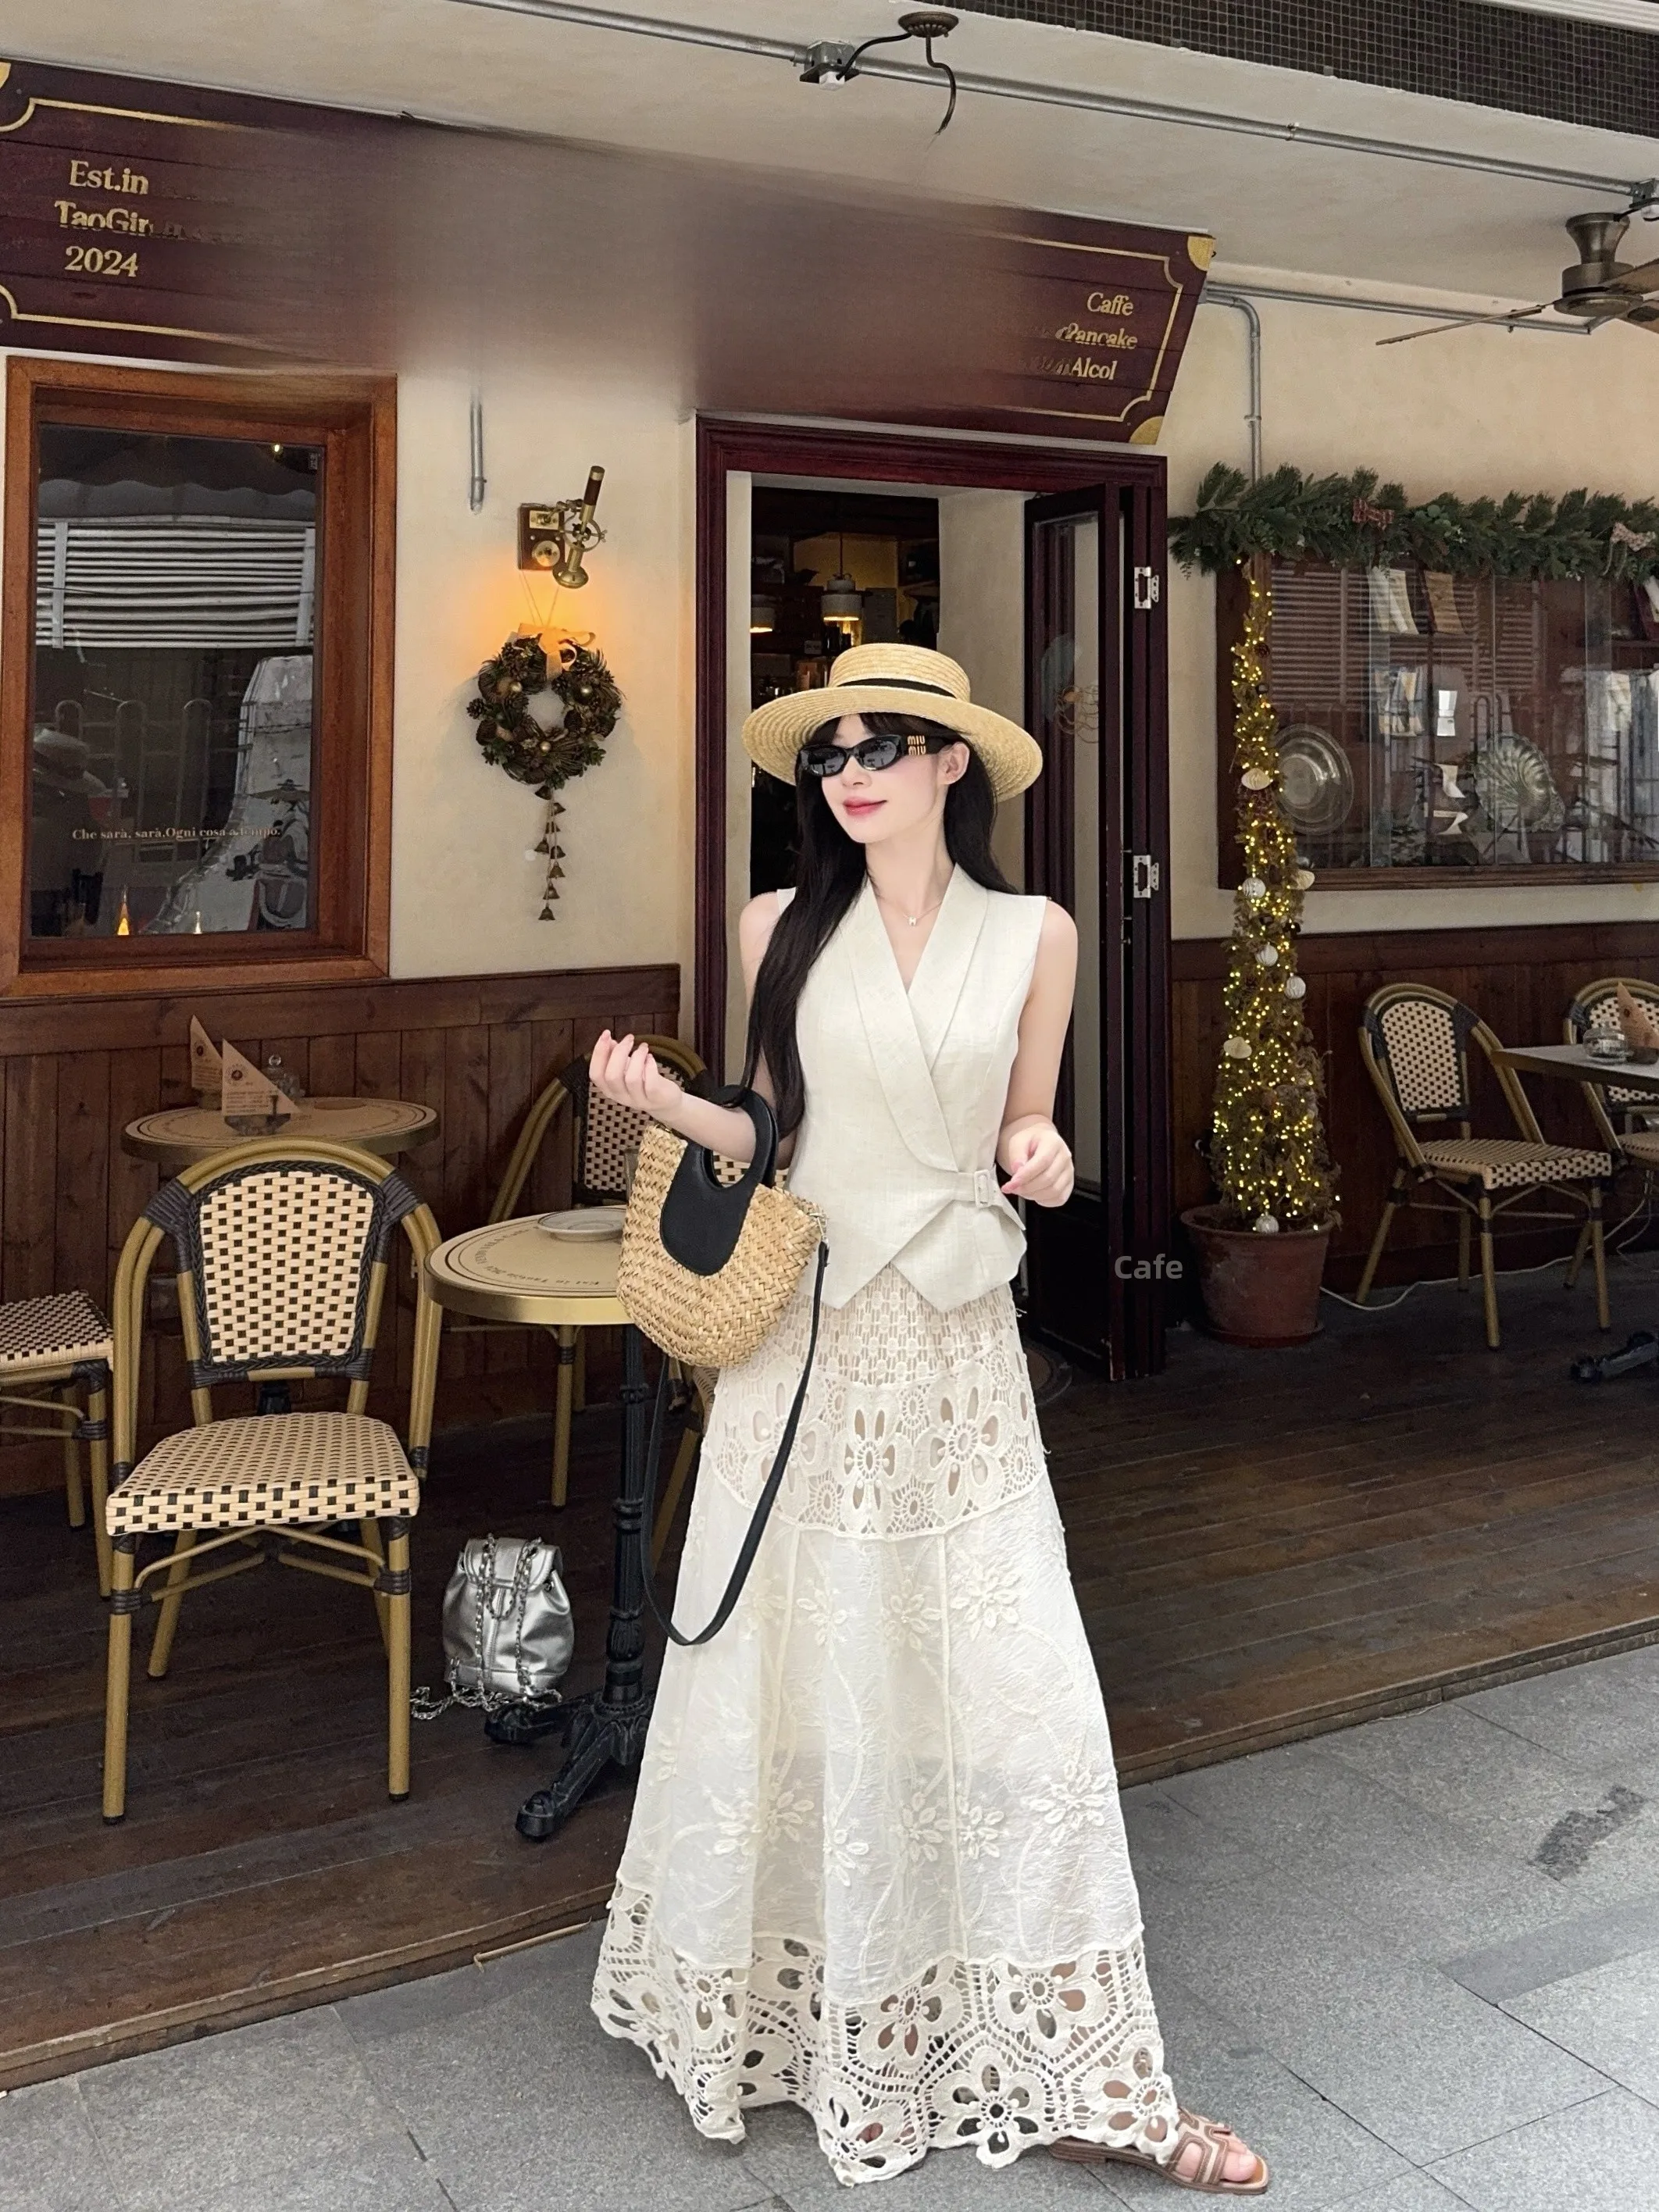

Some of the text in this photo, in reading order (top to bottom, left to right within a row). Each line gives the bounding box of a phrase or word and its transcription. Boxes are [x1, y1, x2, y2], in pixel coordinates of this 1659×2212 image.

[64, 245, 139, 277] 2024
[1071, 356, 1118, 380] Alcol
[72, 828, 98, 840] Che
